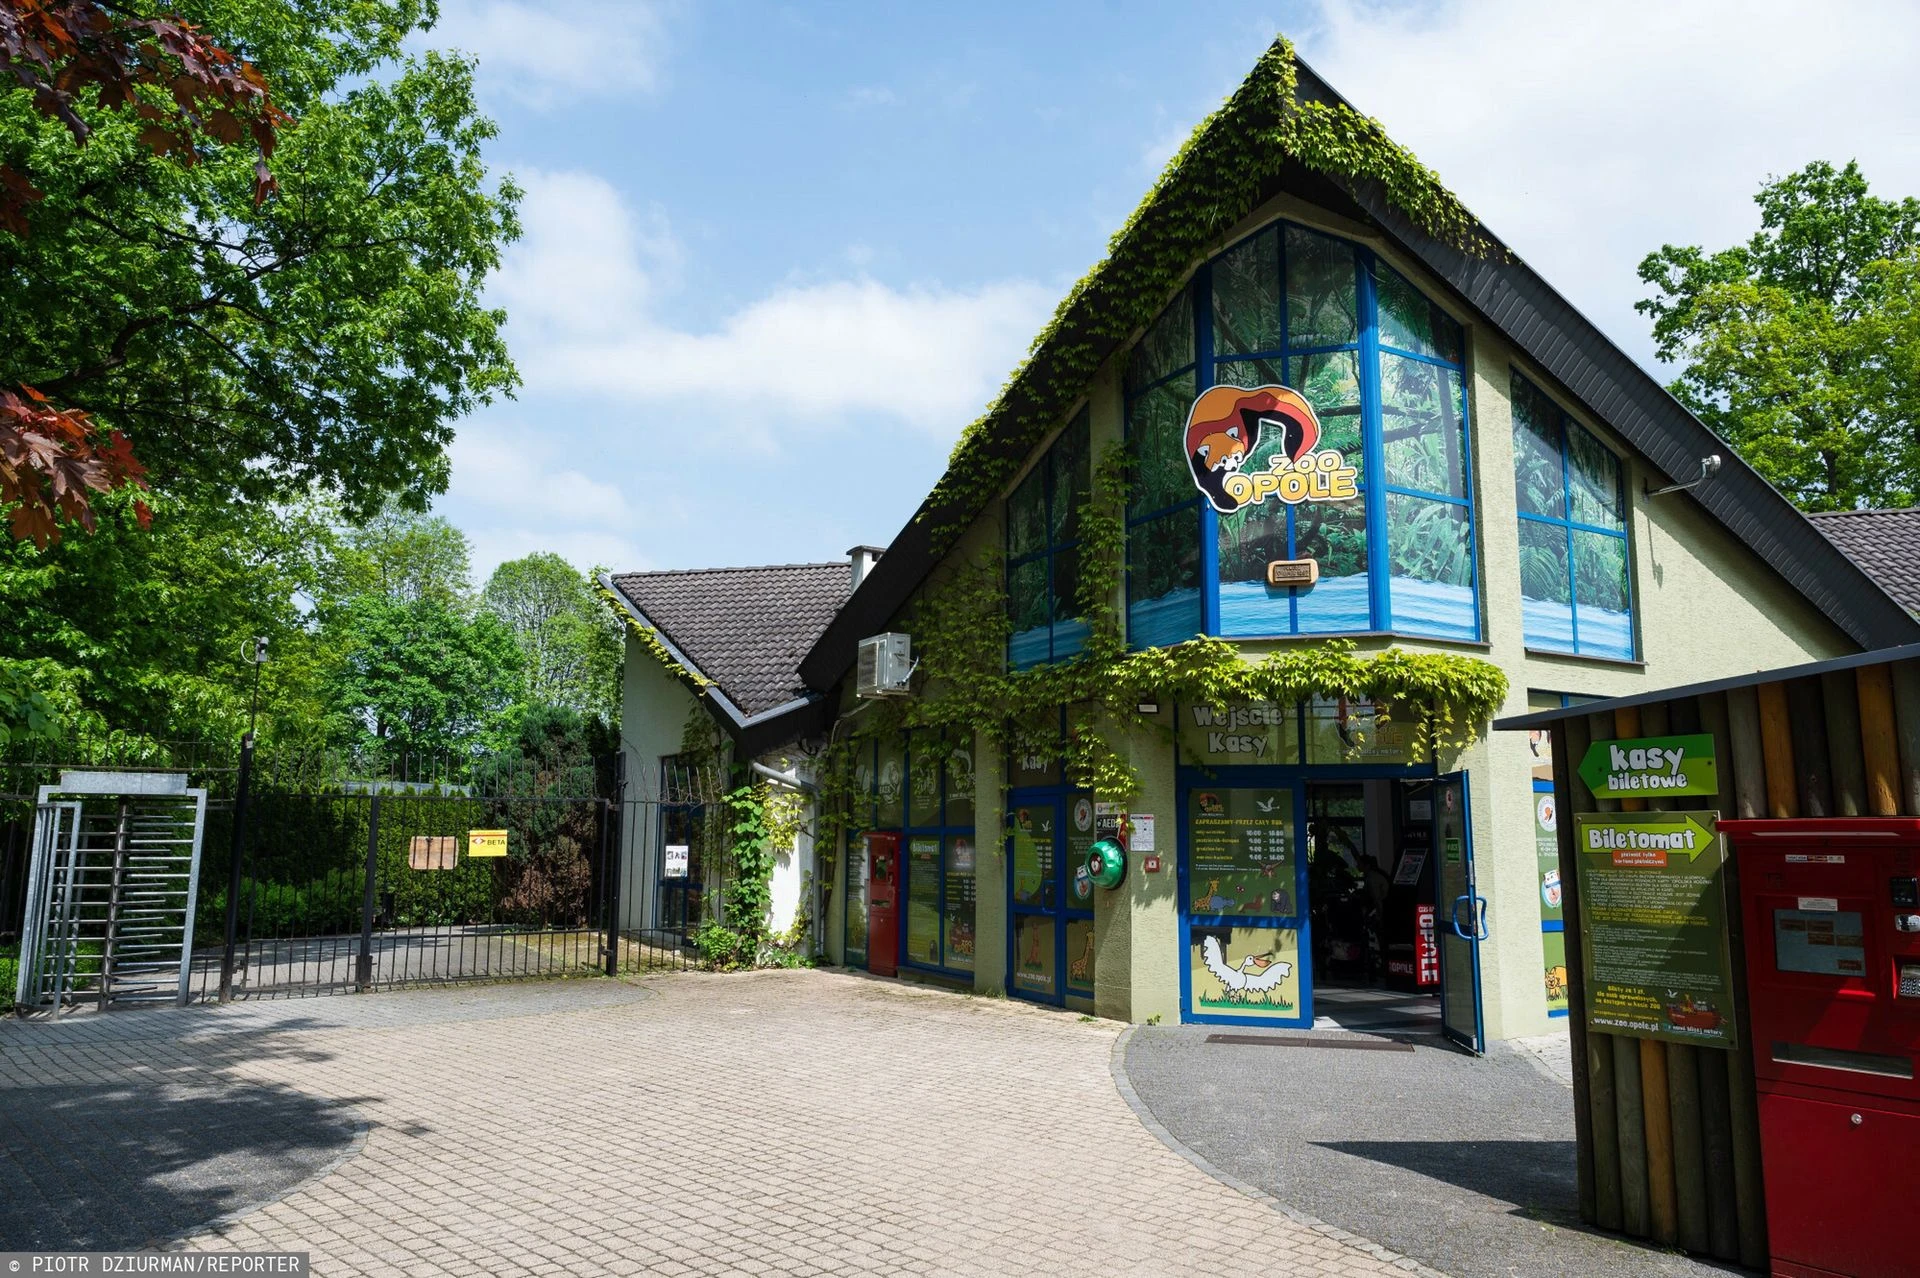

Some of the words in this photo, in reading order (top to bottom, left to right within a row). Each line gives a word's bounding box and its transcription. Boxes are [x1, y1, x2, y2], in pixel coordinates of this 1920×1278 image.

[1270, 452, 1341, 475] ZOO
[1224, 469, 1356, 505] OPOLE
[1192, 704, 1284, 733] Wejście
[1207, 732, 1269, 757] Kasy
[1609, 743, 1685, 777] kasy
[1607, 774, 1687, 791] biletowe
[1588, 828, 1696, 850] Biletomat
[1593, 1017, 1659, 1032] www.zoo.opole.pl
